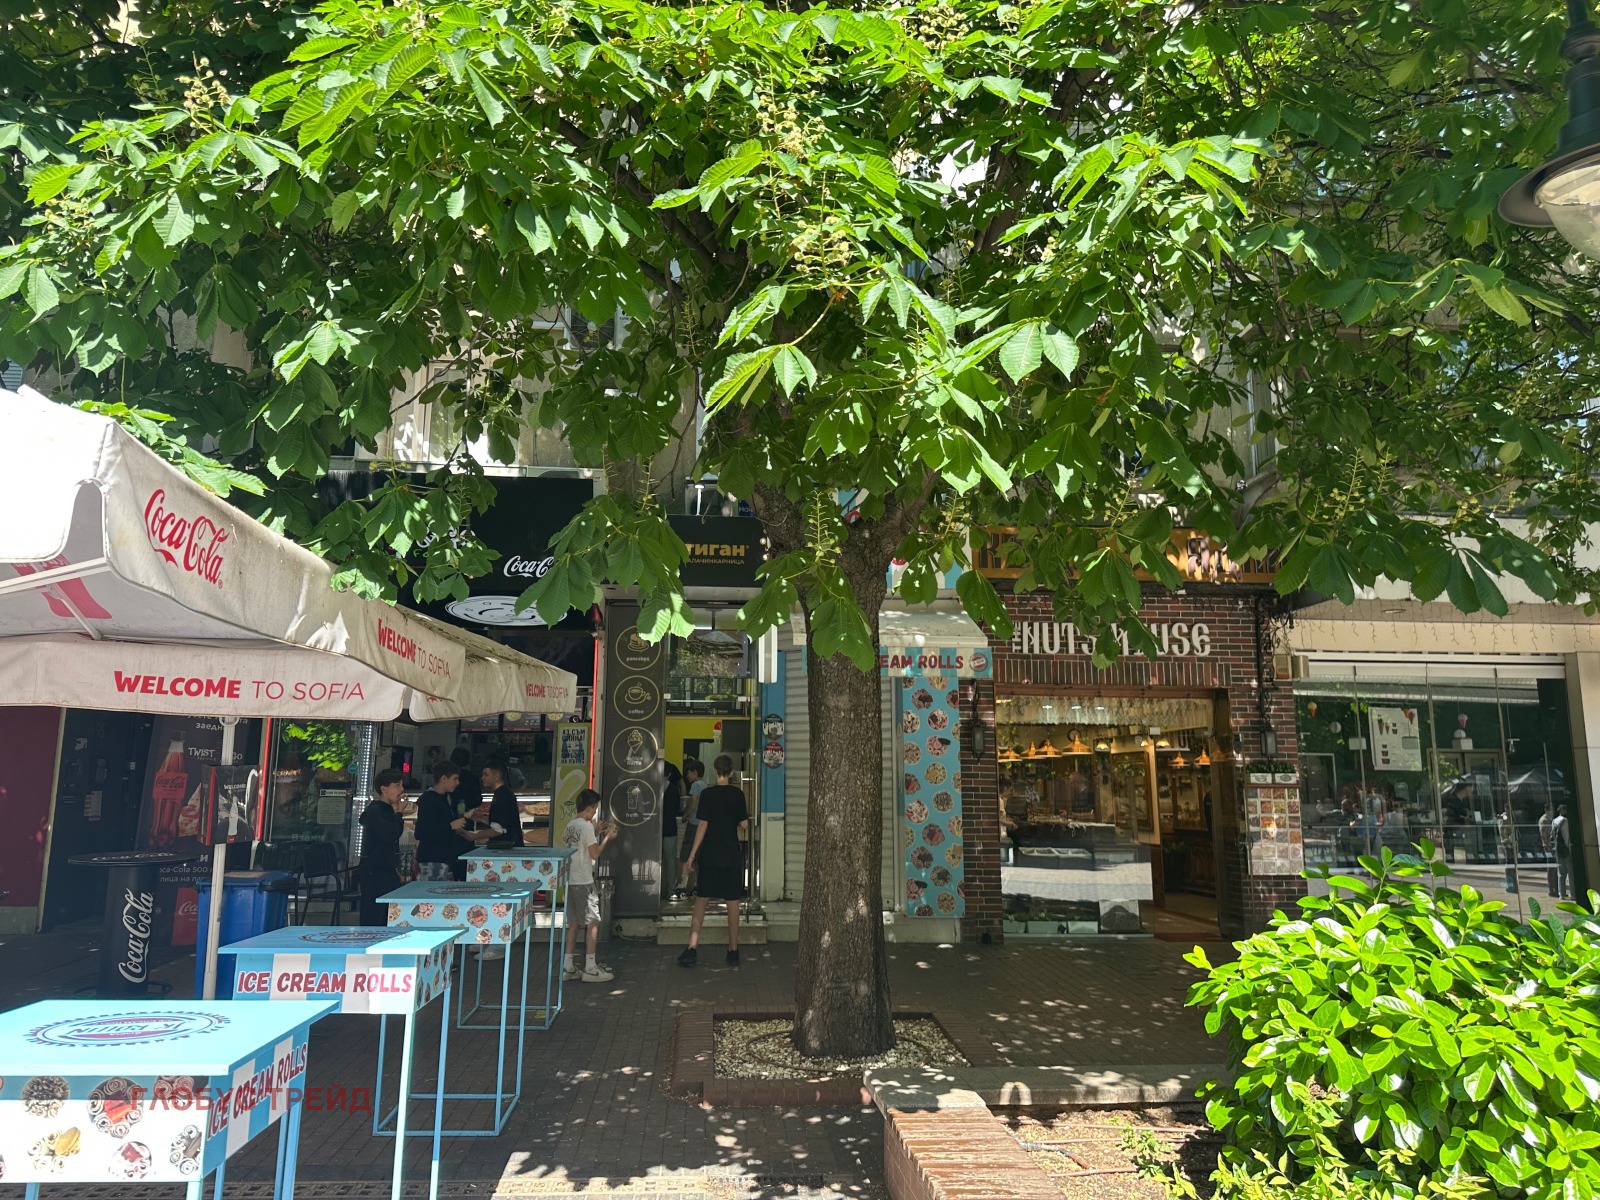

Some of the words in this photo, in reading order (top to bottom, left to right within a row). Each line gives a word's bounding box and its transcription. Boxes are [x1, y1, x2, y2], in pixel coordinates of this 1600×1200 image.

[503, 555, 555, 578] Coca-C
[685, 558, 745, 566] АЛАЧИНКАРНИЦА
[378, 618, 417, 664] WELCOME
[418, 647, 426, 669] TO
[429, 654, 451, 679] SOFIA
[1111, 622, 1211, 657] HUSE
[880, 654, 913, 669] EAM
[918, 654, 964, 670] ROLLS
[114, 670, 242, 699] WELCOME
[252, 680, 285, 700] TO
[293, 682, 365, 701] SOFIA
[195, 722, 223, 732] заедн
[188, 747, 215, 758] TWIST
[118, 887, 154, 984] Coca-Cola
[238, 972, 271, 993] ICE
[276, 972, 347, 993] CREAM
[353, 973, 412, 993] ROLLS
[207, 1090, 232, 1139] ICE
[233, 1063, 275, 1120] CREAM
[276, 1042, 307, 1088] ROLLS
